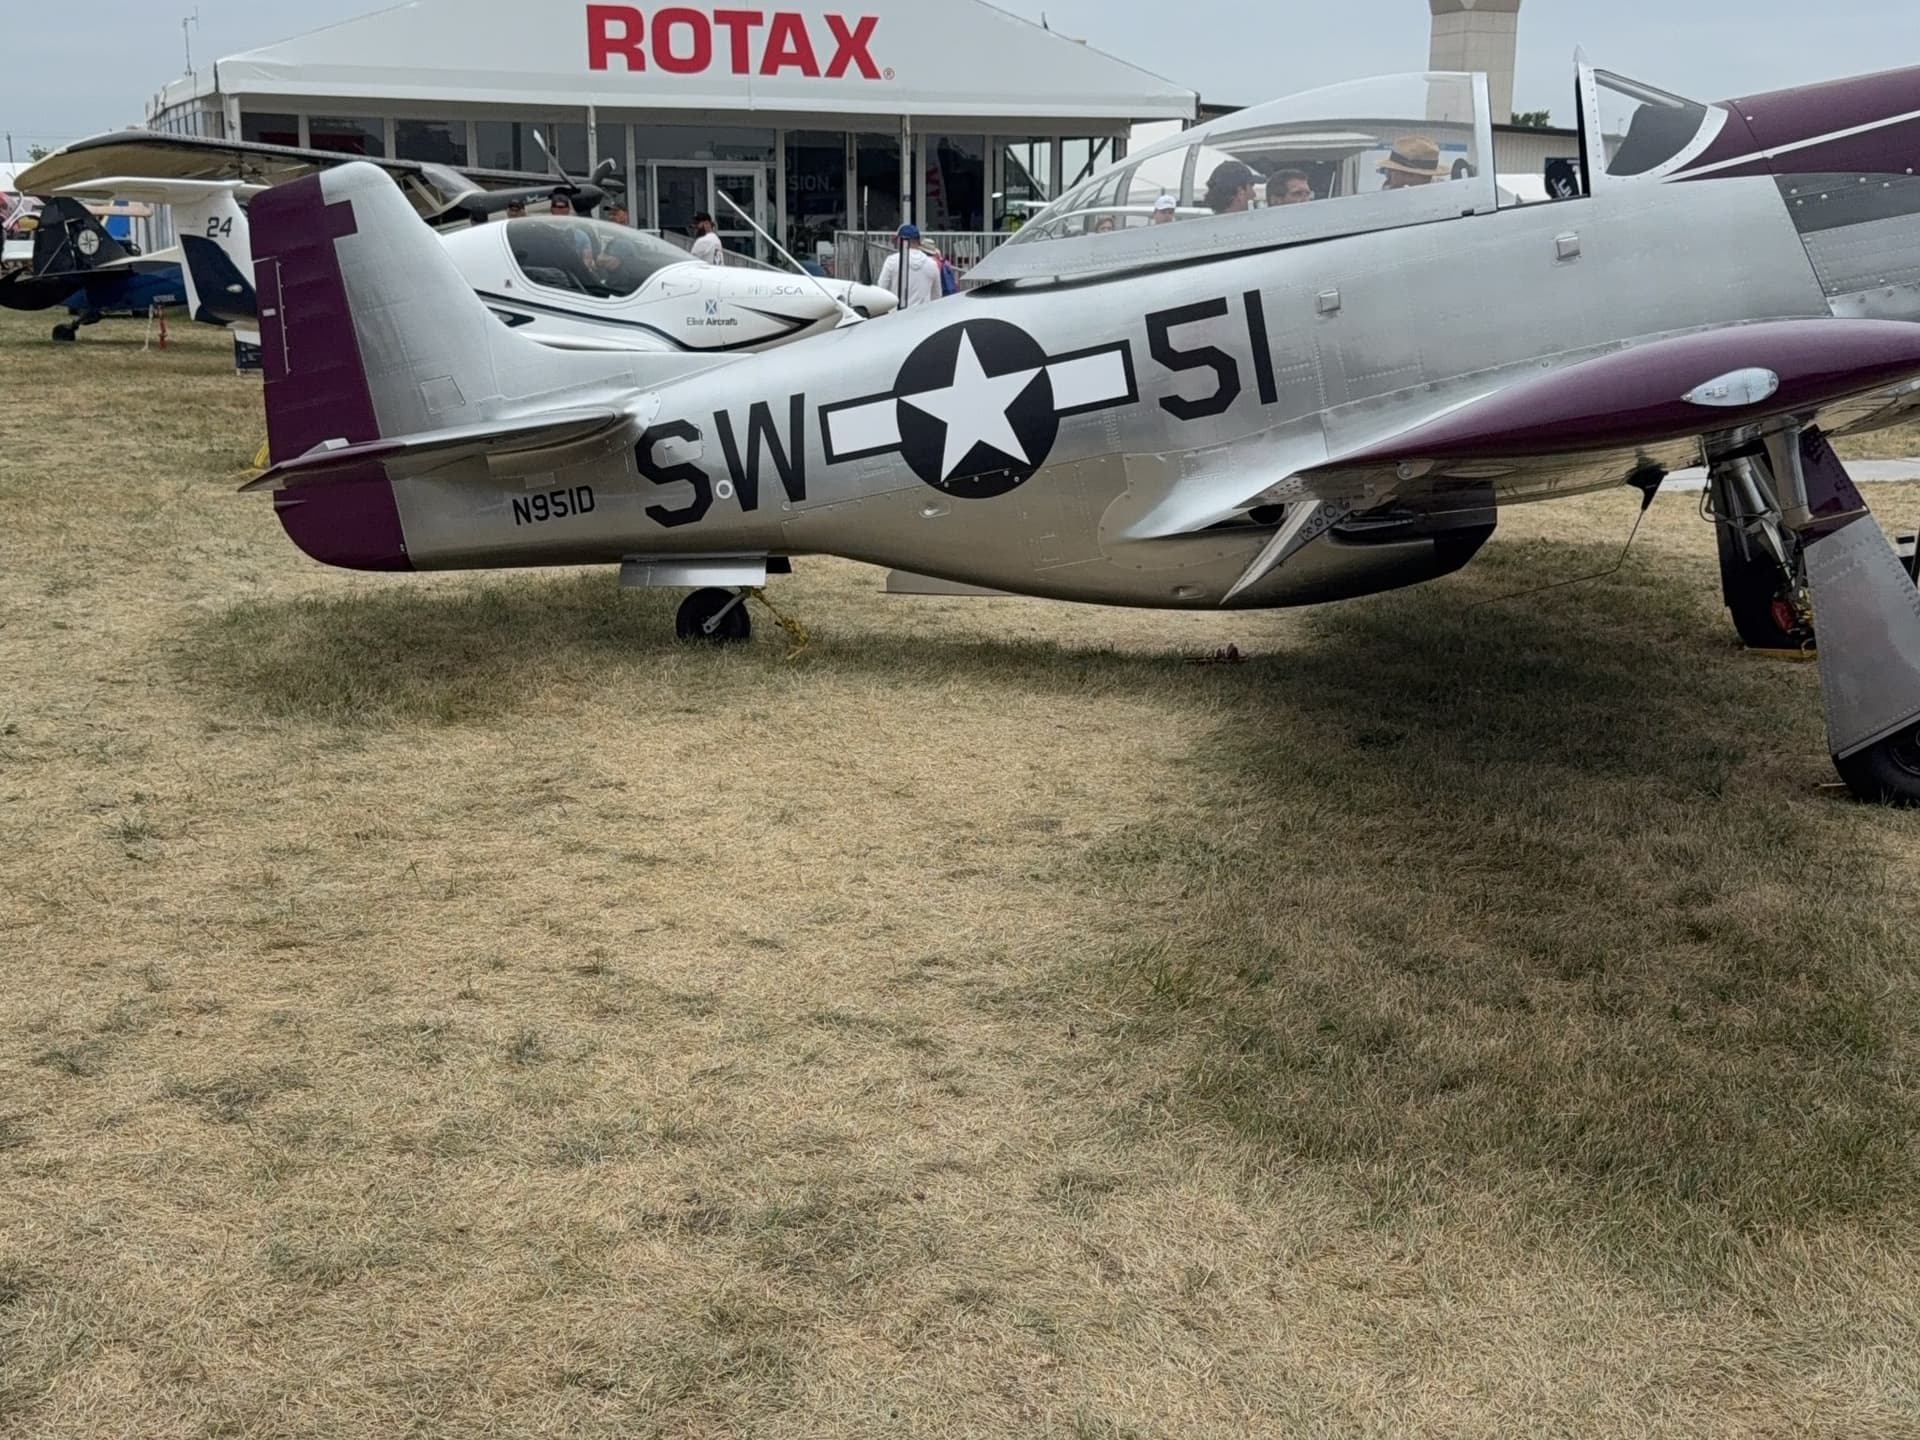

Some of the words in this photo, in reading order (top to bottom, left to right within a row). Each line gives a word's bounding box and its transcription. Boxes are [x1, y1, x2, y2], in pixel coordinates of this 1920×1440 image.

[586, 4, 882, 80] ROTAX
[207, 216, 232, 238] 24
[706, 317, 738, 326] Aircraft
[635, 392, 806, 528] SW
[1145, 289, 1278, 421] 51
[512, 485, 595, 525] N951D
